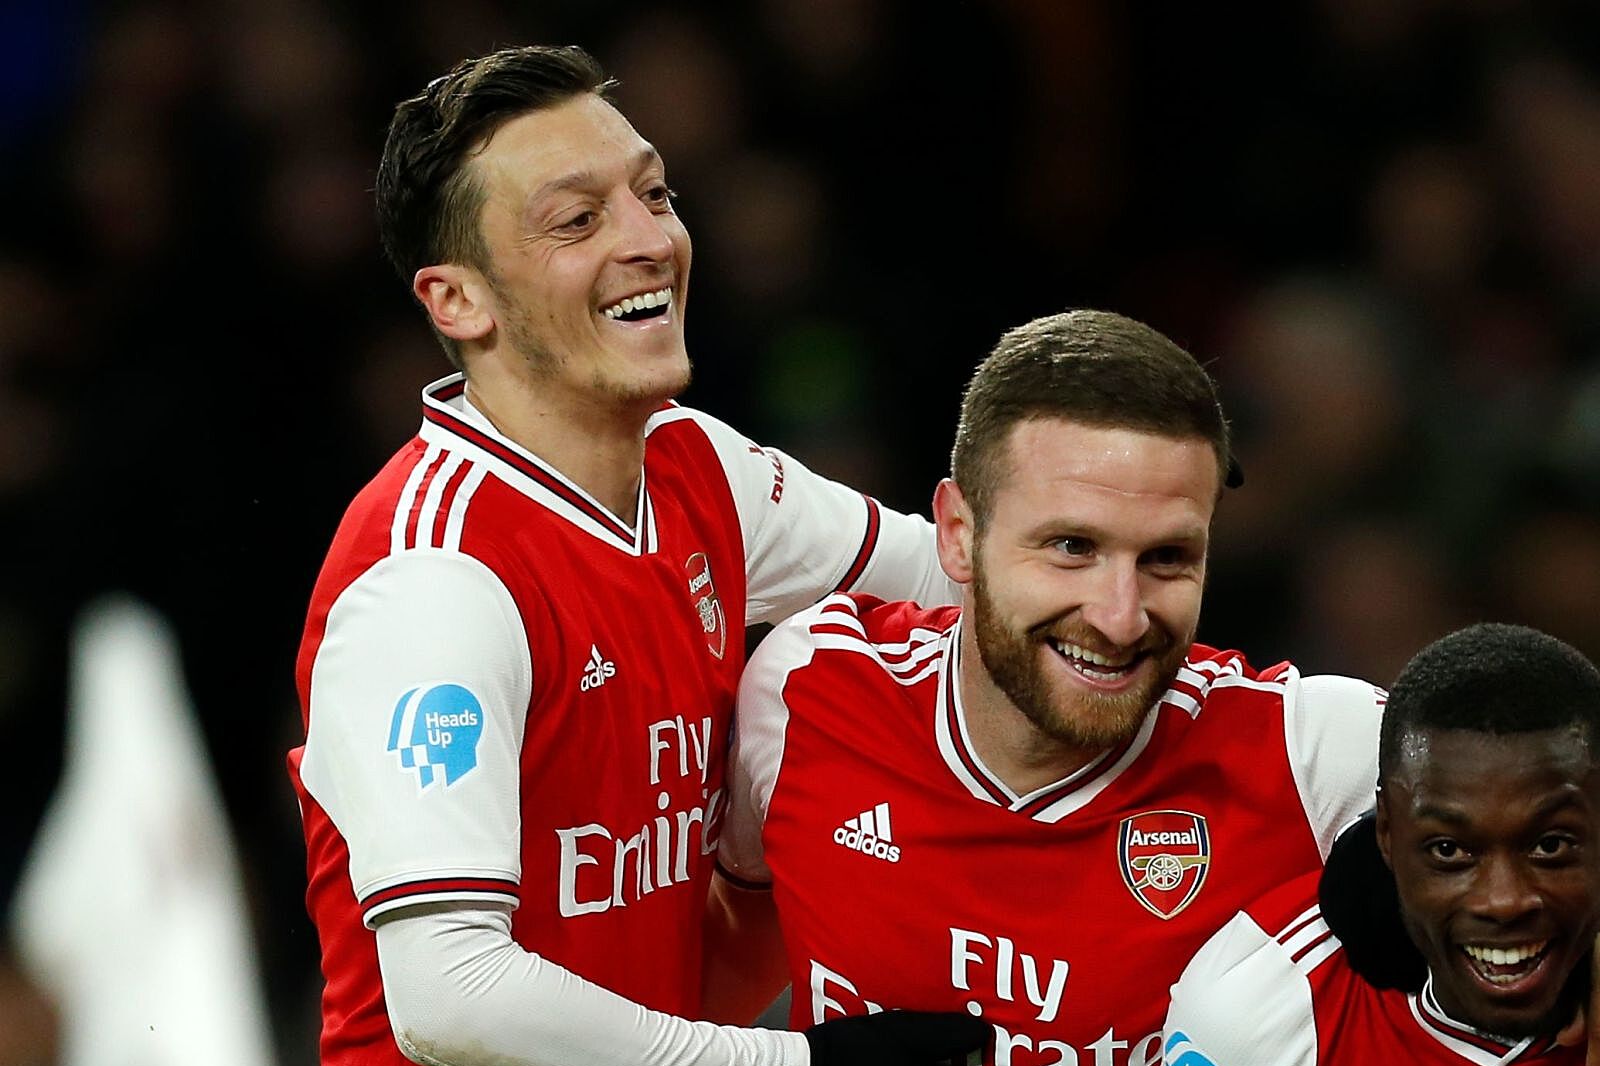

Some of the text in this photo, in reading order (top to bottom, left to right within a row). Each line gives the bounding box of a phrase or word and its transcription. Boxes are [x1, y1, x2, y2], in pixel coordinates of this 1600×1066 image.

[425, 709, 478, 729] Heads
[427, 729, 452, 748] Up
[648, 715, 712, 785] Fly
[833, 827, 901, 863] adidas
[1129, 827, 1198, 847] Arsenal
[949, 927, 1070, 1023] Fly
